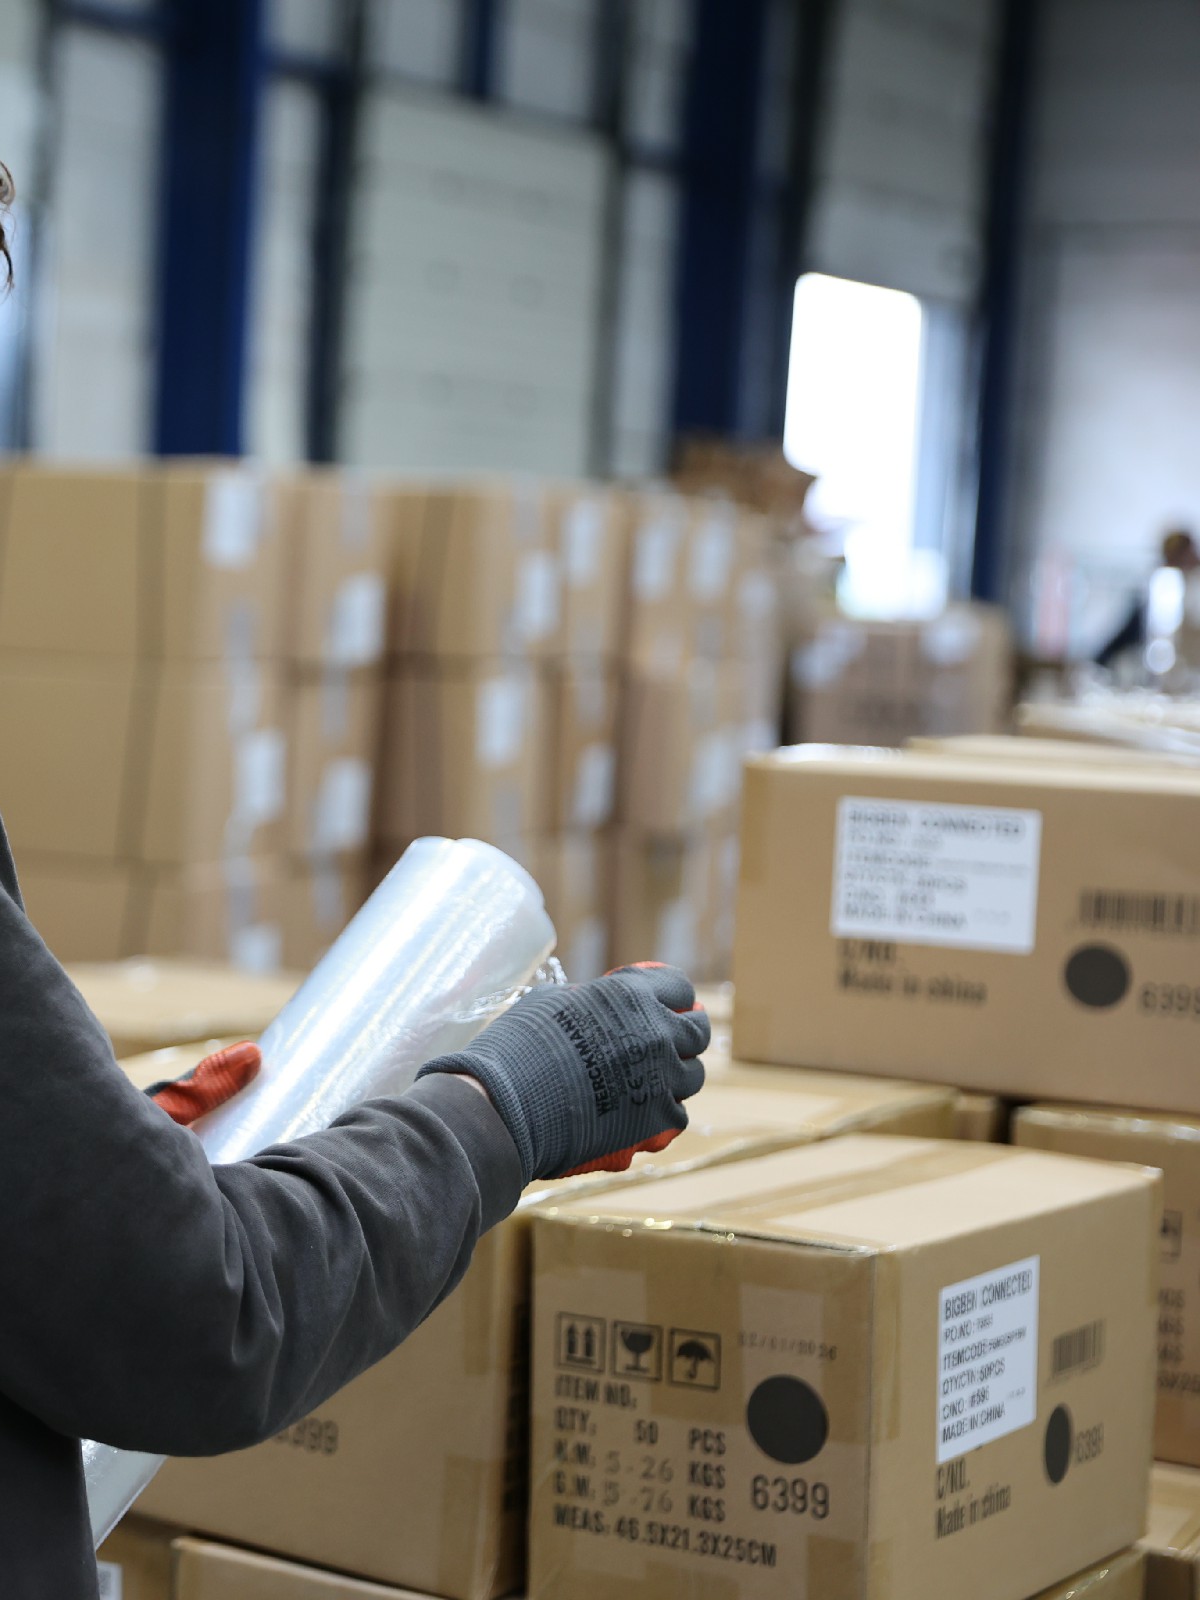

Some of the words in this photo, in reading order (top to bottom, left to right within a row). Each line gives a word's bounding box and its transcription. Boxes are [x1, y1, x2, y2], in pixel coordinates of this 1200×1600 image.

[552, 1010, 610, 1118] WERCKMANN
[982, 1269, 1032, 1306] CONNECTED
[635, 1419, 659, 1445] 50
[688, 1428, 727, 1456] PCS
[943, 1418, 968, 1443] MADE
[970, 1413, 979, 1430] IN
[981, 1402, 1006, 1425] CHINA
[688, 1461, 727, 1490] KGS
[687, 1494, 727, 1523] KGS
[751, 1474, 831, 1520] 6399
